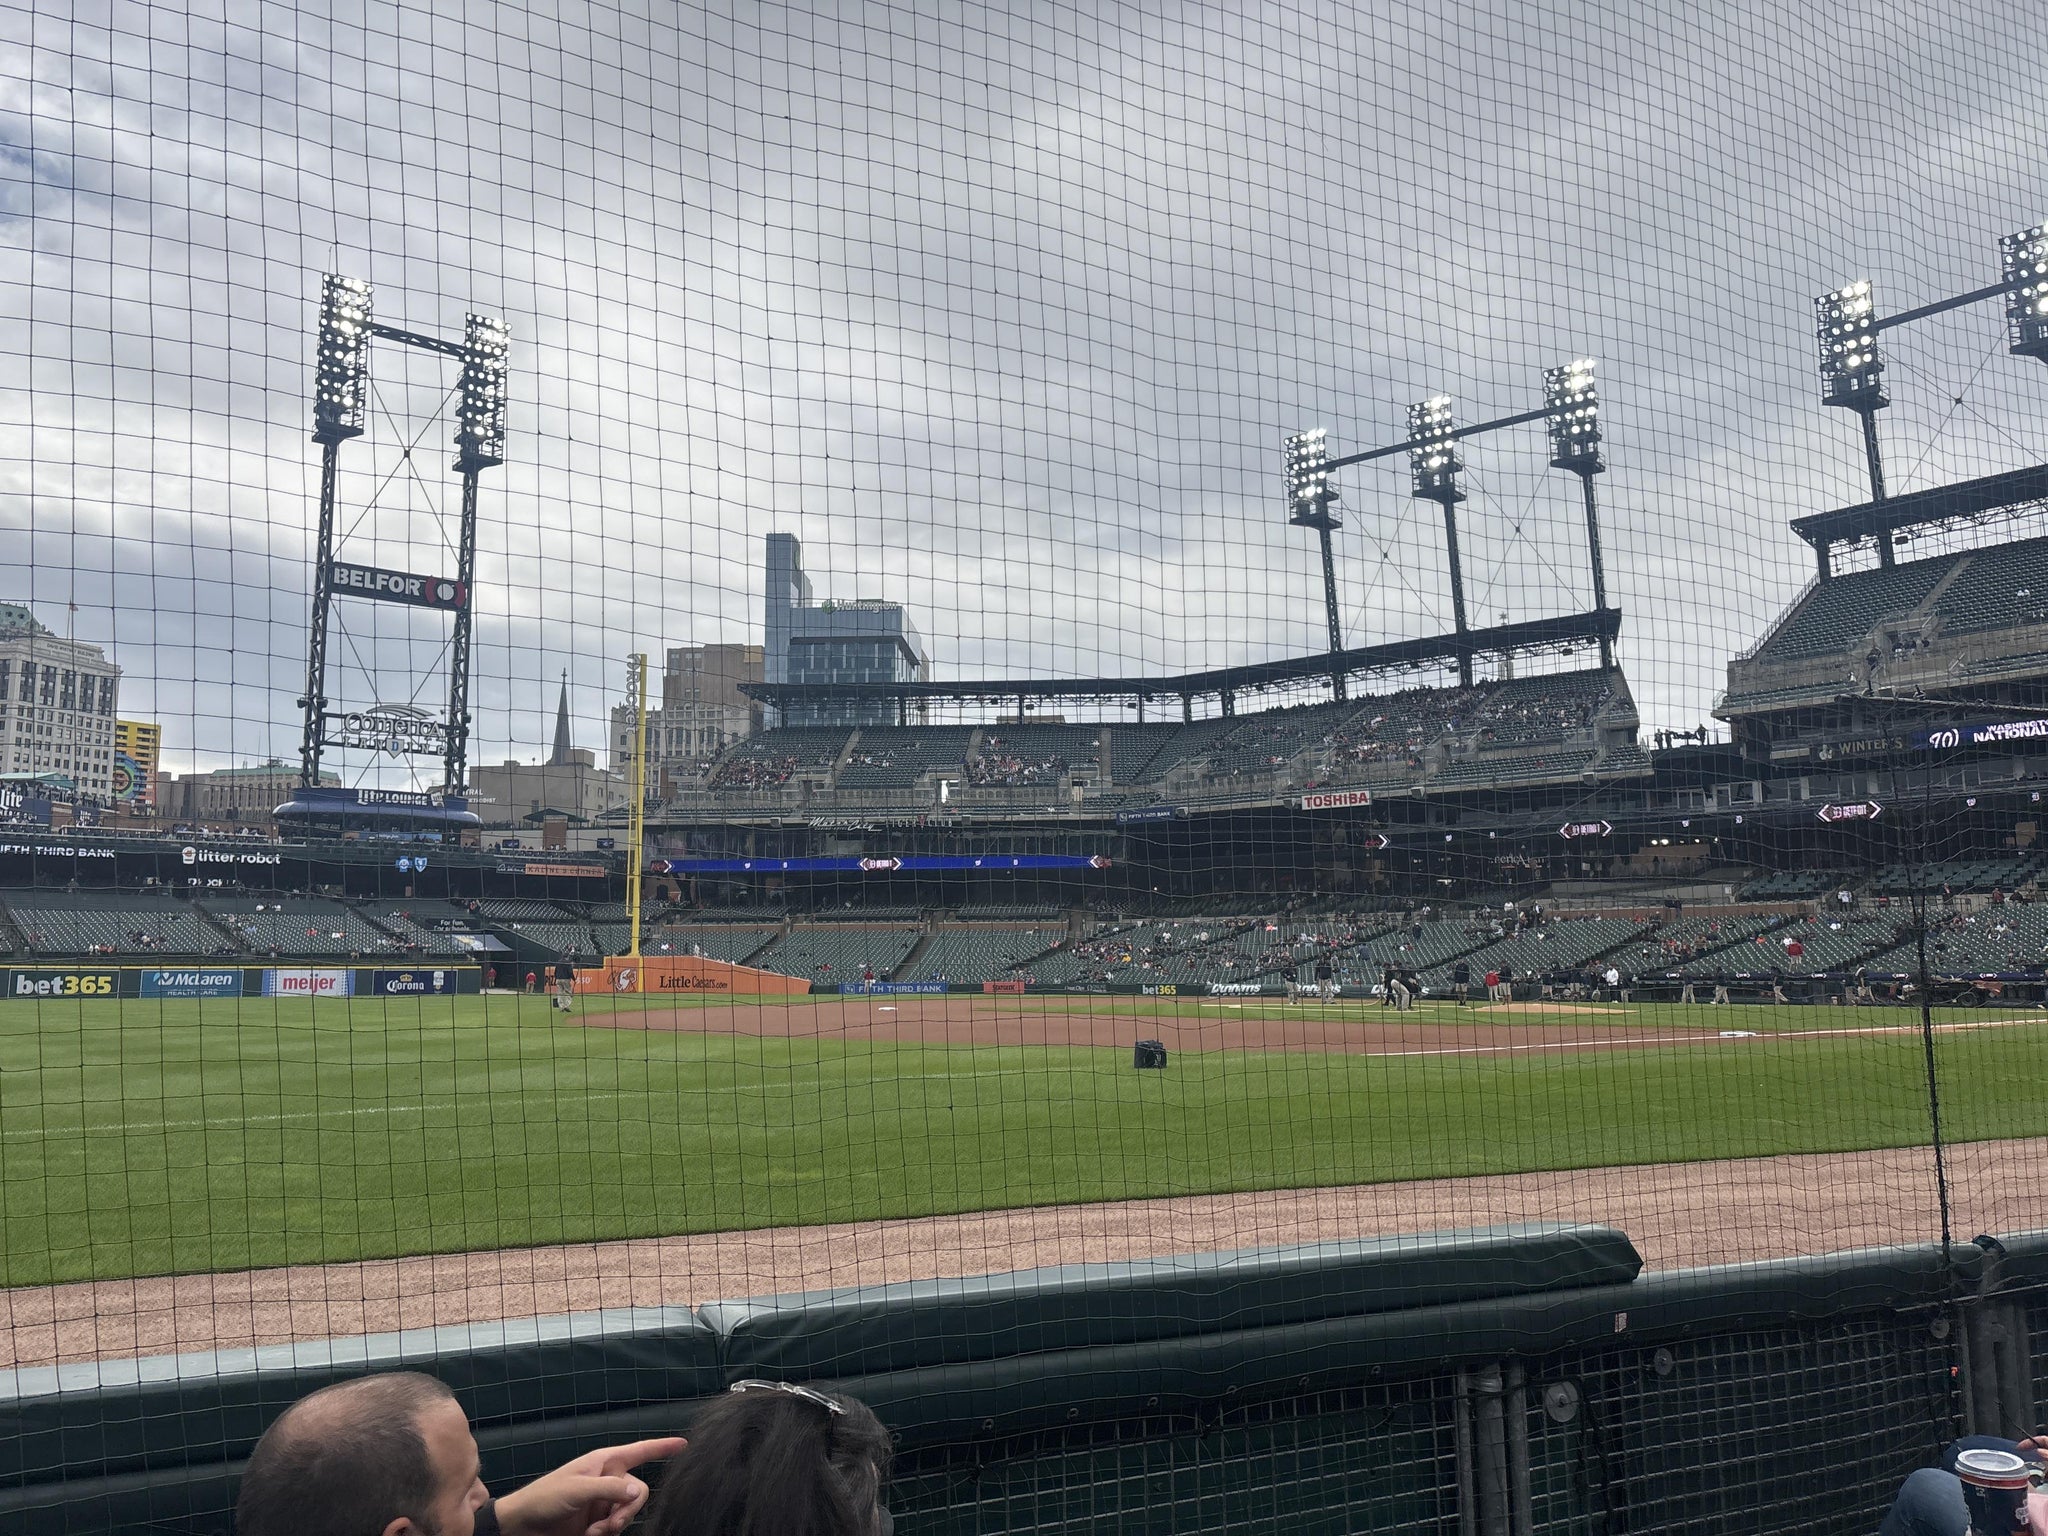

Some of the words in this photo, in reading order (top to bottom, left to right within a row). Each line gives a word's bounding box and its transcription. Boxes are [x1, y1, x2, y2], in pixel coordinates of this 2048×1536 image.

[333, 567, 421, 596] BELFOR
[837, 600, 897, 614] Huntington
[0, 787, 24, 809] Lite
[386, 793, 428, 806] LOUNGE
[1304, 792, 1369, 808] TOSHIBA
[35, 846, 75, 857] THIRD
[78, 848, 115, 858] BANK
[16, 974, 112, 994] bet365
[174, 972, 233, 986] McLaren
[282, 973, 337, 993] meijer
[386, 979, 425, 993] Corona
[659, 975, 691, 989] Little
[887, 984, 914, 993] THIRD
[917, 983, 942, 993] BANK
[1142, 985, 1177, 995] bet365
